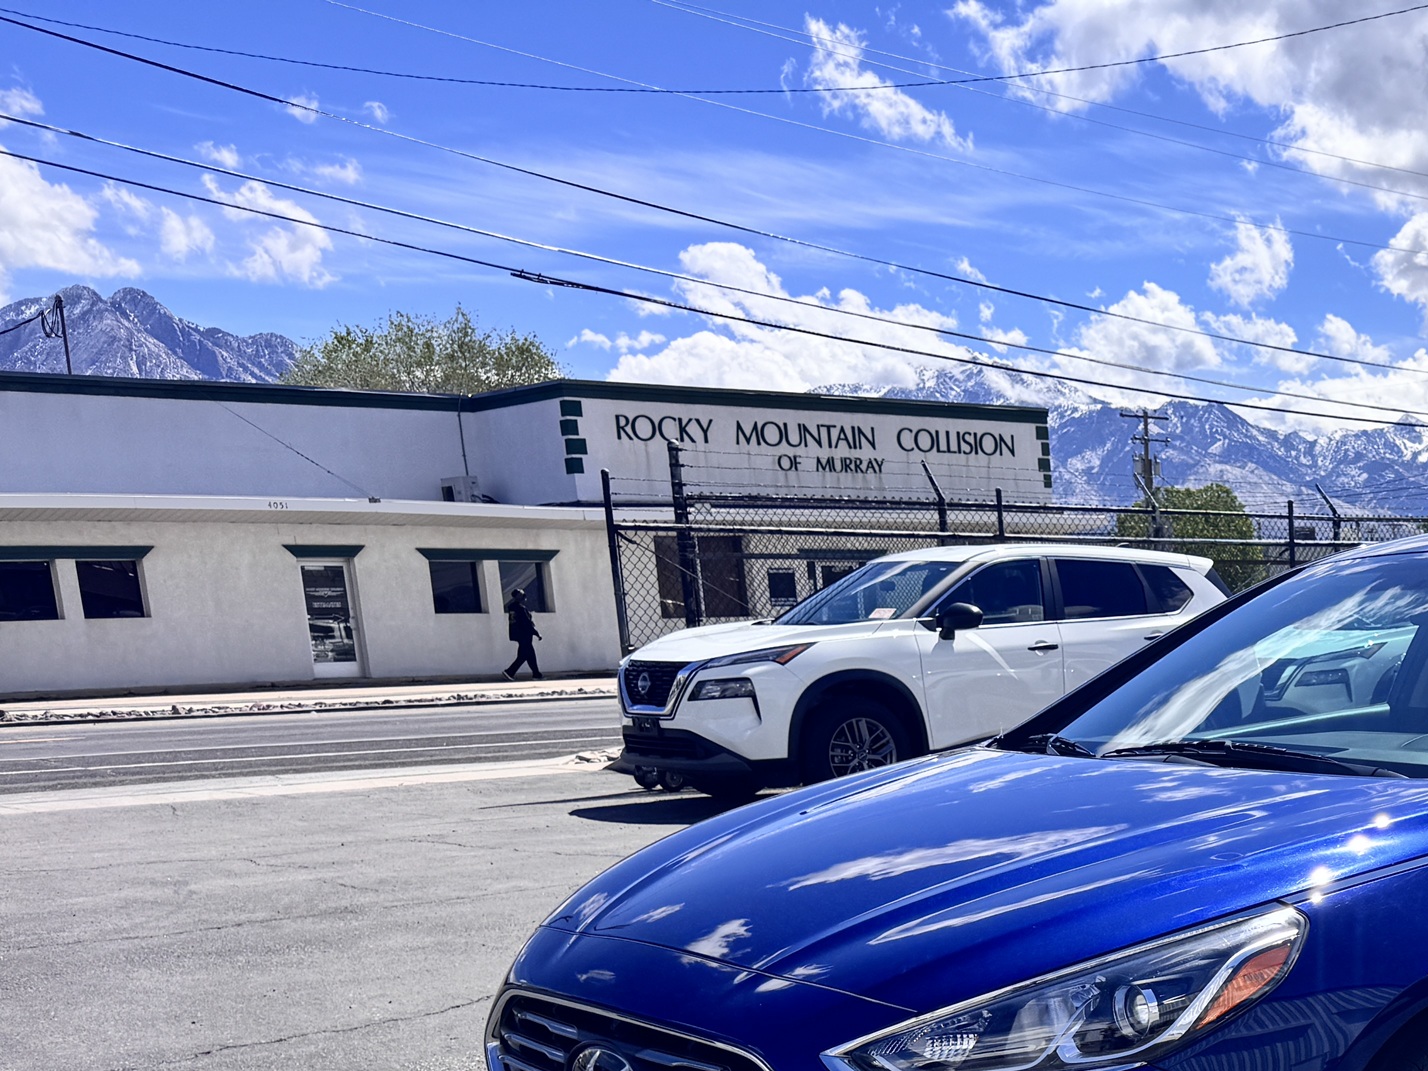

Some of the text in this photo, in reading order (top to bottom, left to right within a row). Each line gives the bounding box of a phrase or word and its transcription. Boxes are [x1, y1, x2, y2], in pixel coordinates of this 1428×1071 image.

[615, 414, 1015, 457] ROCKY MOUNTAIN COLLISION
[777, 454, 884, 474] OF MURRAY
[268, 501, 288, 509] 4051
